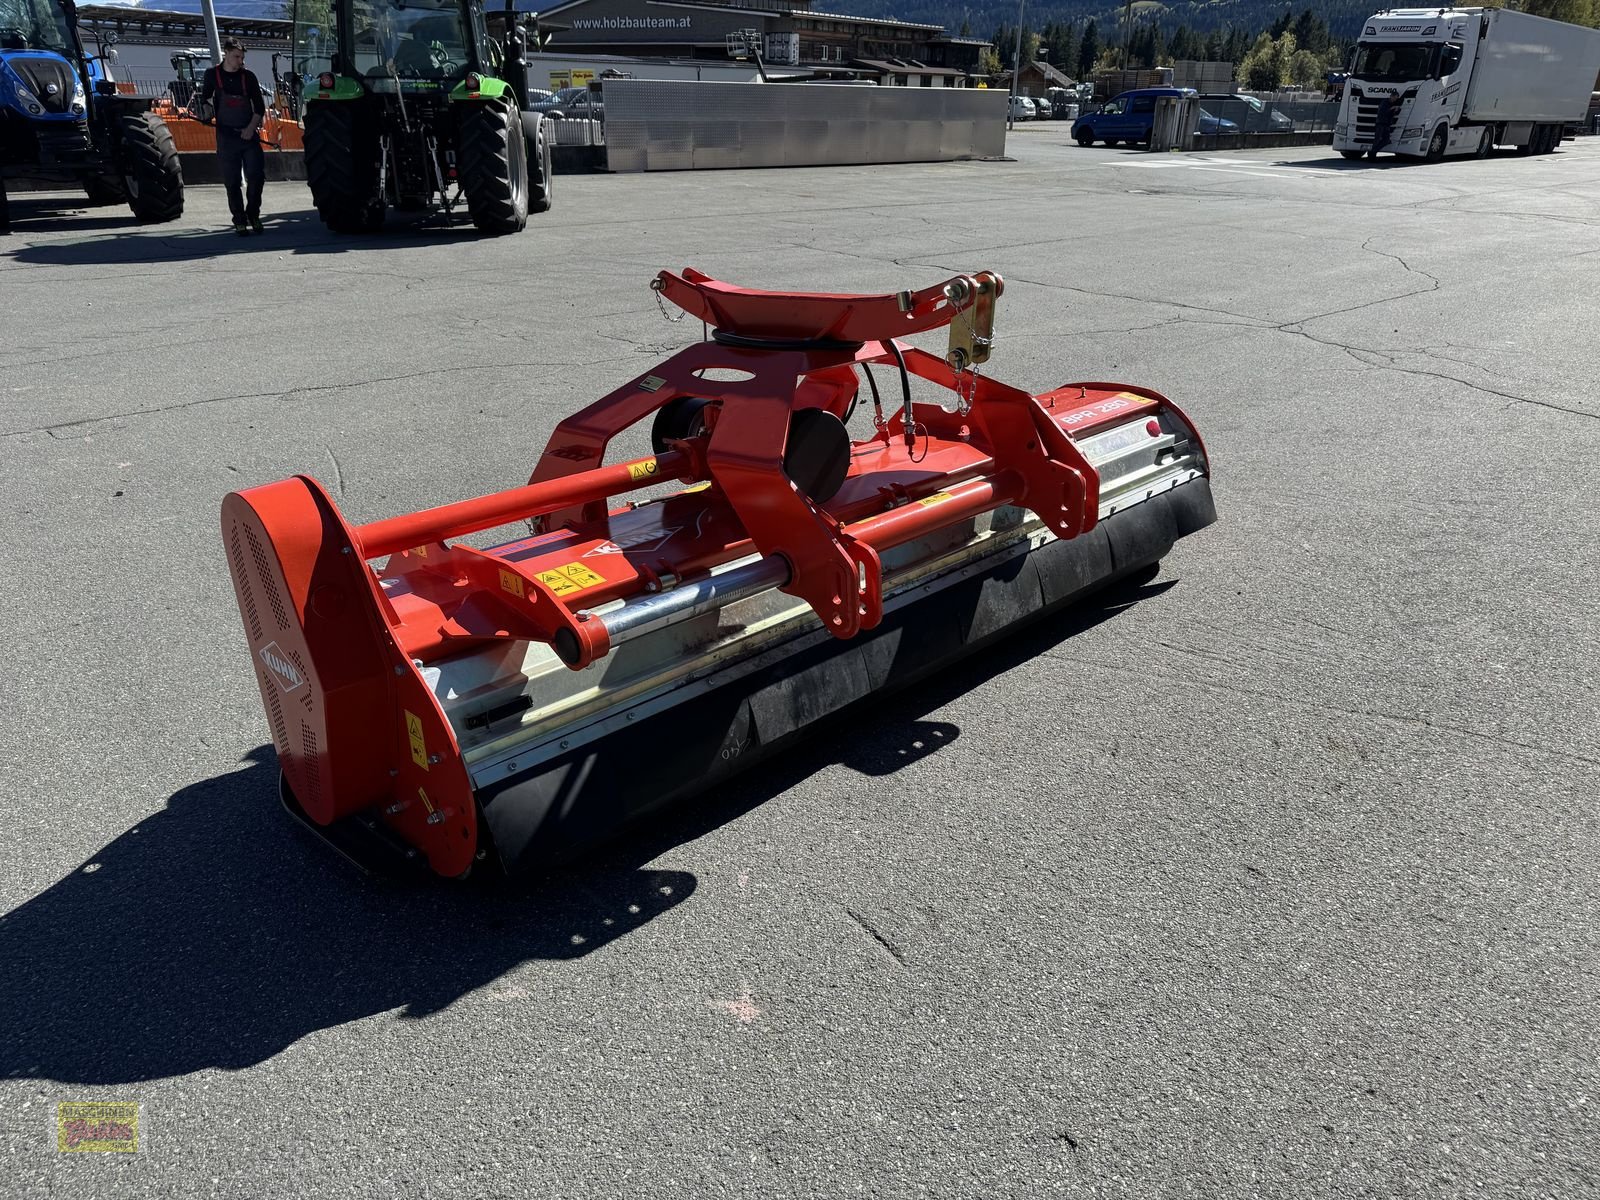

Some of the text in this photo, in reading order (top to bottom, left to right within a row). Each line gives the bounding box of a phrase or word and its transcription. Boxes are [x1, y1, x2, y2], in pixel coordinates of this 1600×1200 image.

[573, 16, 692, 29] www.holzbauteam.at
[1061, 399, 1130, 425] BPR 280
[262, 650, 298, 685] KUHN
